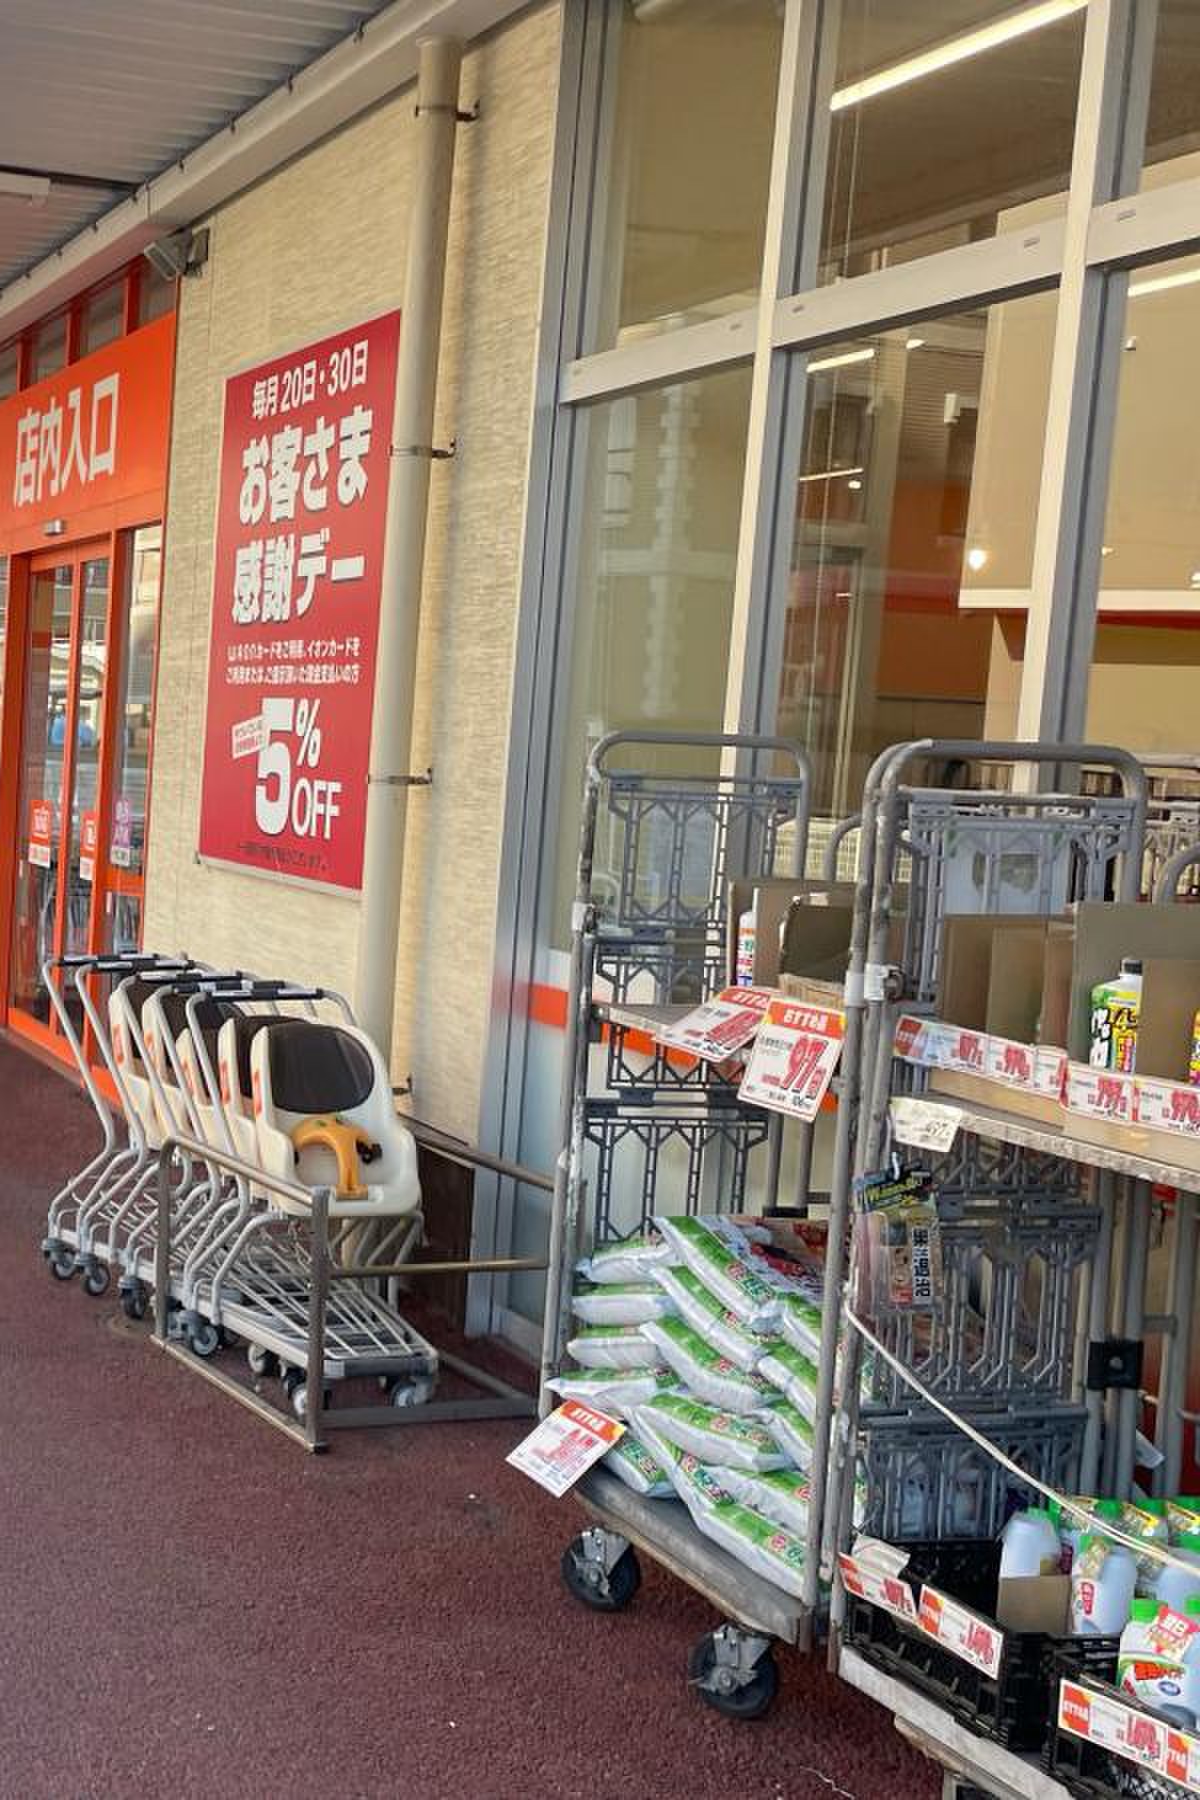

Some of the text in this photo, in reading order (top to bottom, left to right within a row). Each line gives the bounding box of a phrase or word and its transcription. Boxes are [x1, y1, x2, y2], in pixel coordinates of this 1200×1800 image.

[13, 373, 119, 507] 店内入口
[239, 405, 373, 525] お客さま
[232, 528, 365, 624] 感謝デー
[293, 777, 342, 840] OFF
